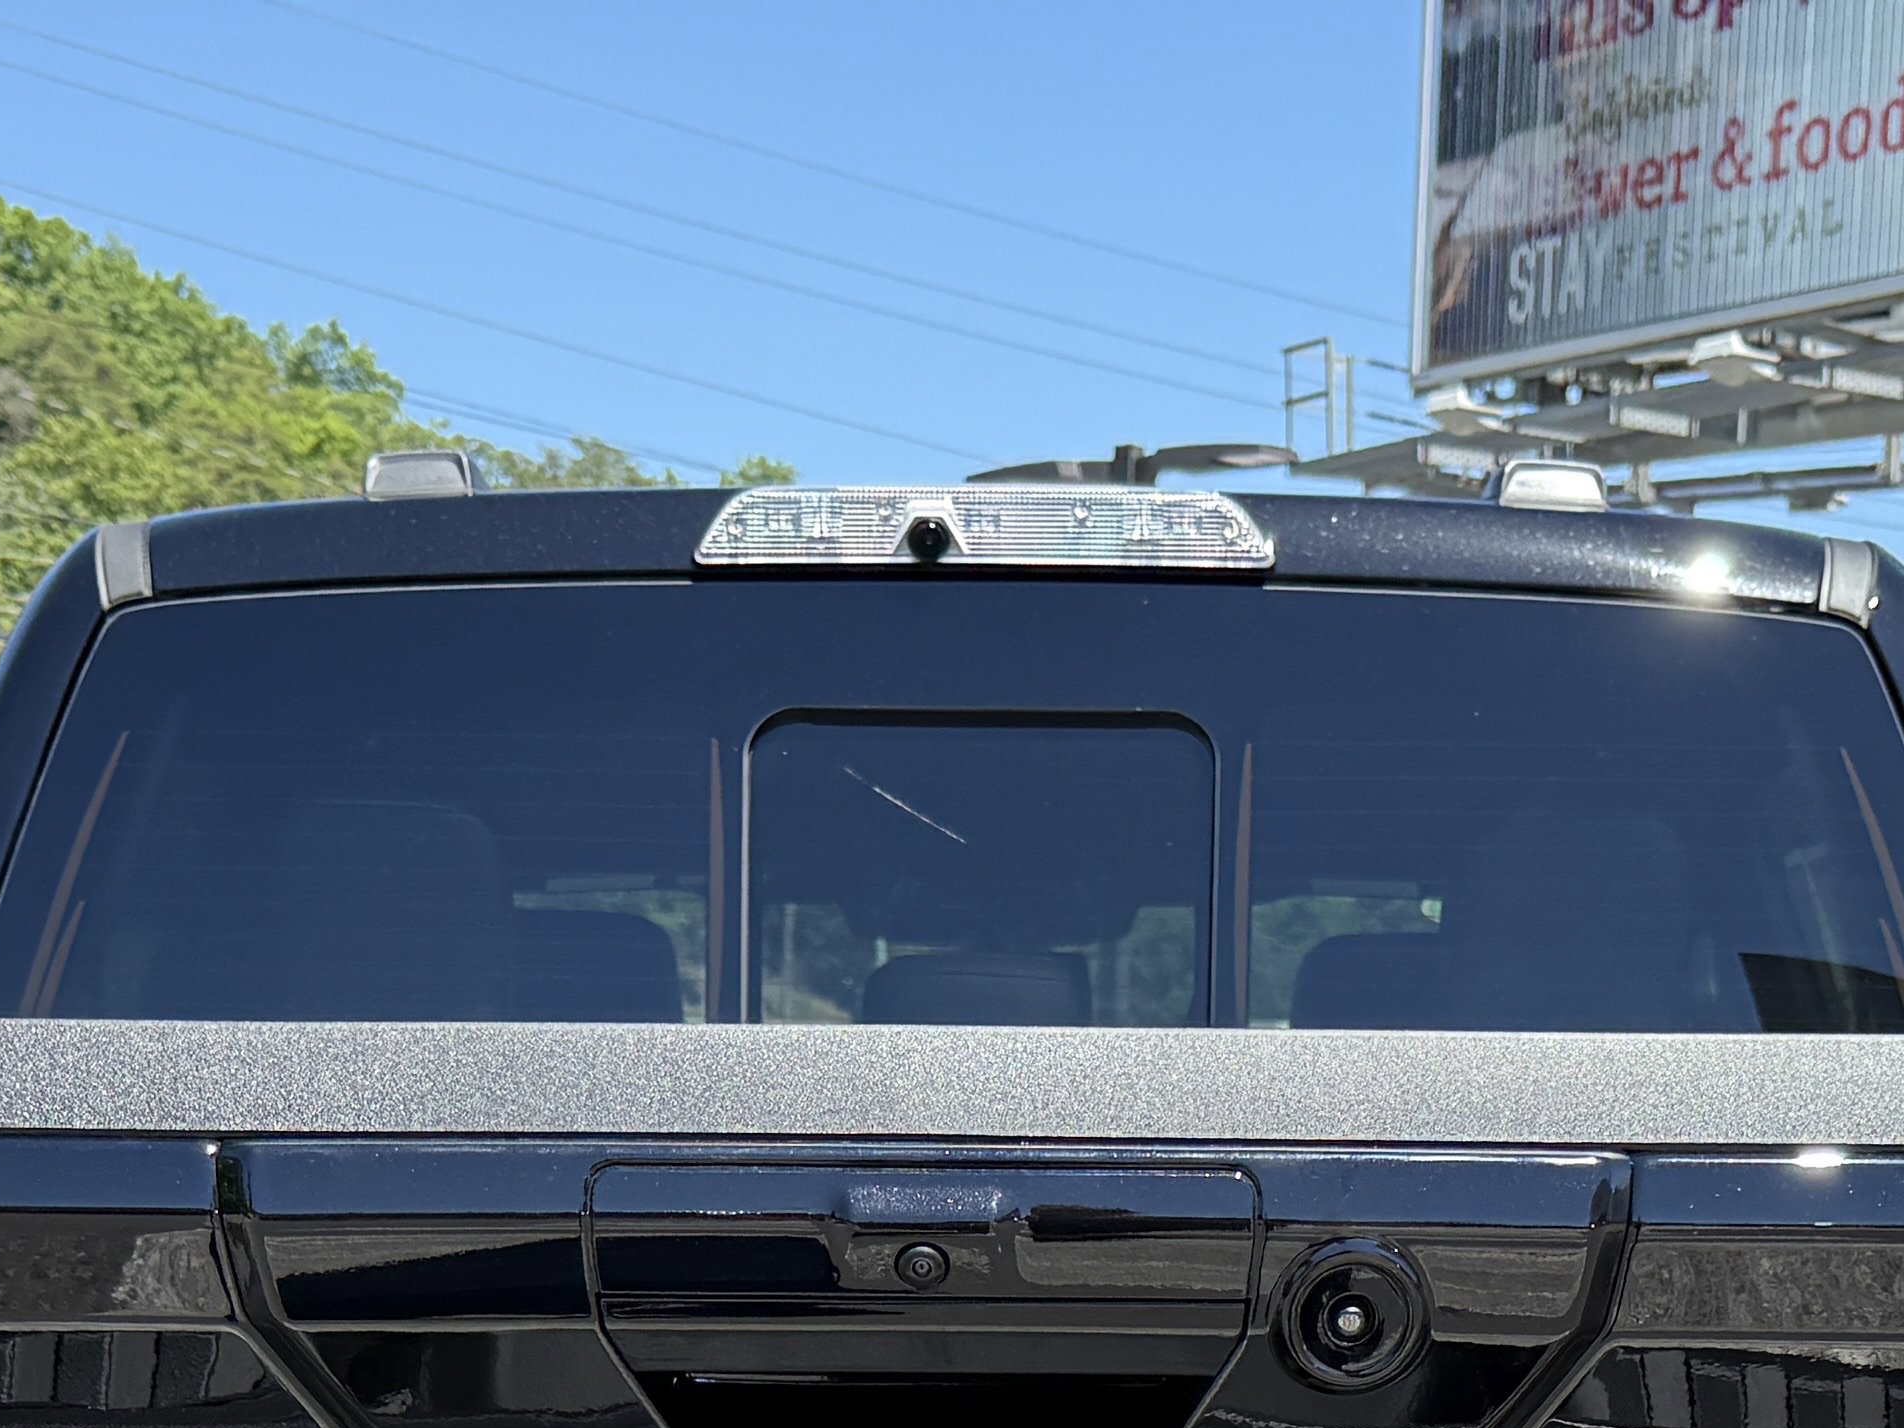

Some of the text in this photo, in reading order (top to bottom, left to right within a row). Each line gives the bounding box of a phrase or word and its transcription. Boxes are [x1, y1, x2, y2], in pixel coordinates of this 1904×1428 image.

[1711, 116, 1753, 192] &
[1507, 226, 1612, 325] STAY
[1611, 197, 1844, 283] FESTIVAL
